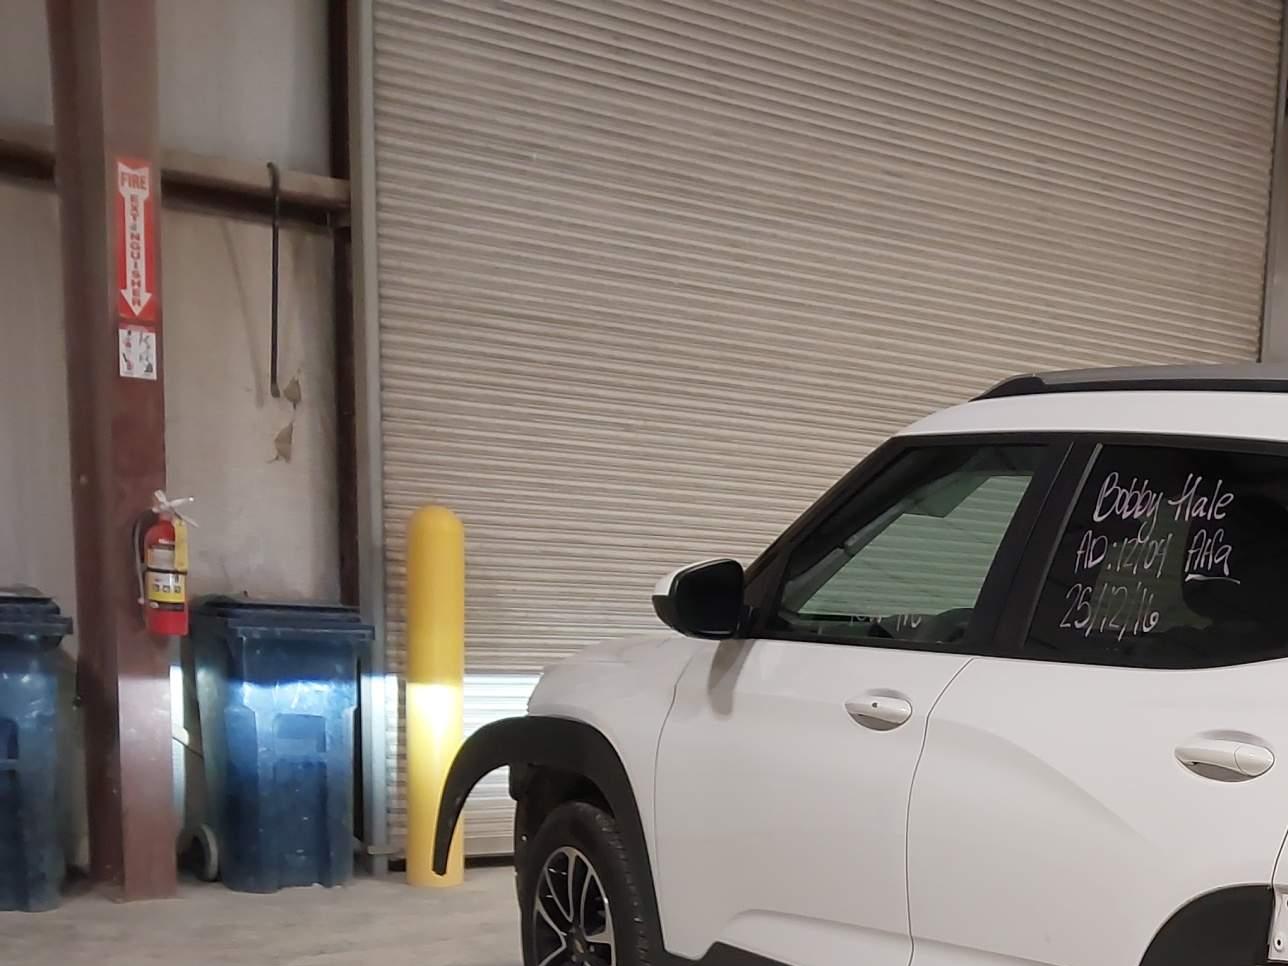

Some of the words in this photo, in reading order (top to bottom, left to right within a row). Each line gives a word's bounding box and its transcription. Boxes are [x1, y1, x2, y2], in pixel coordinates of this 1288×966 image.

[120, 171, 147, 191] FIRE
[1093, 471, 1163, 544] Bobby
[1168, 473, 1234, 522] Hale
